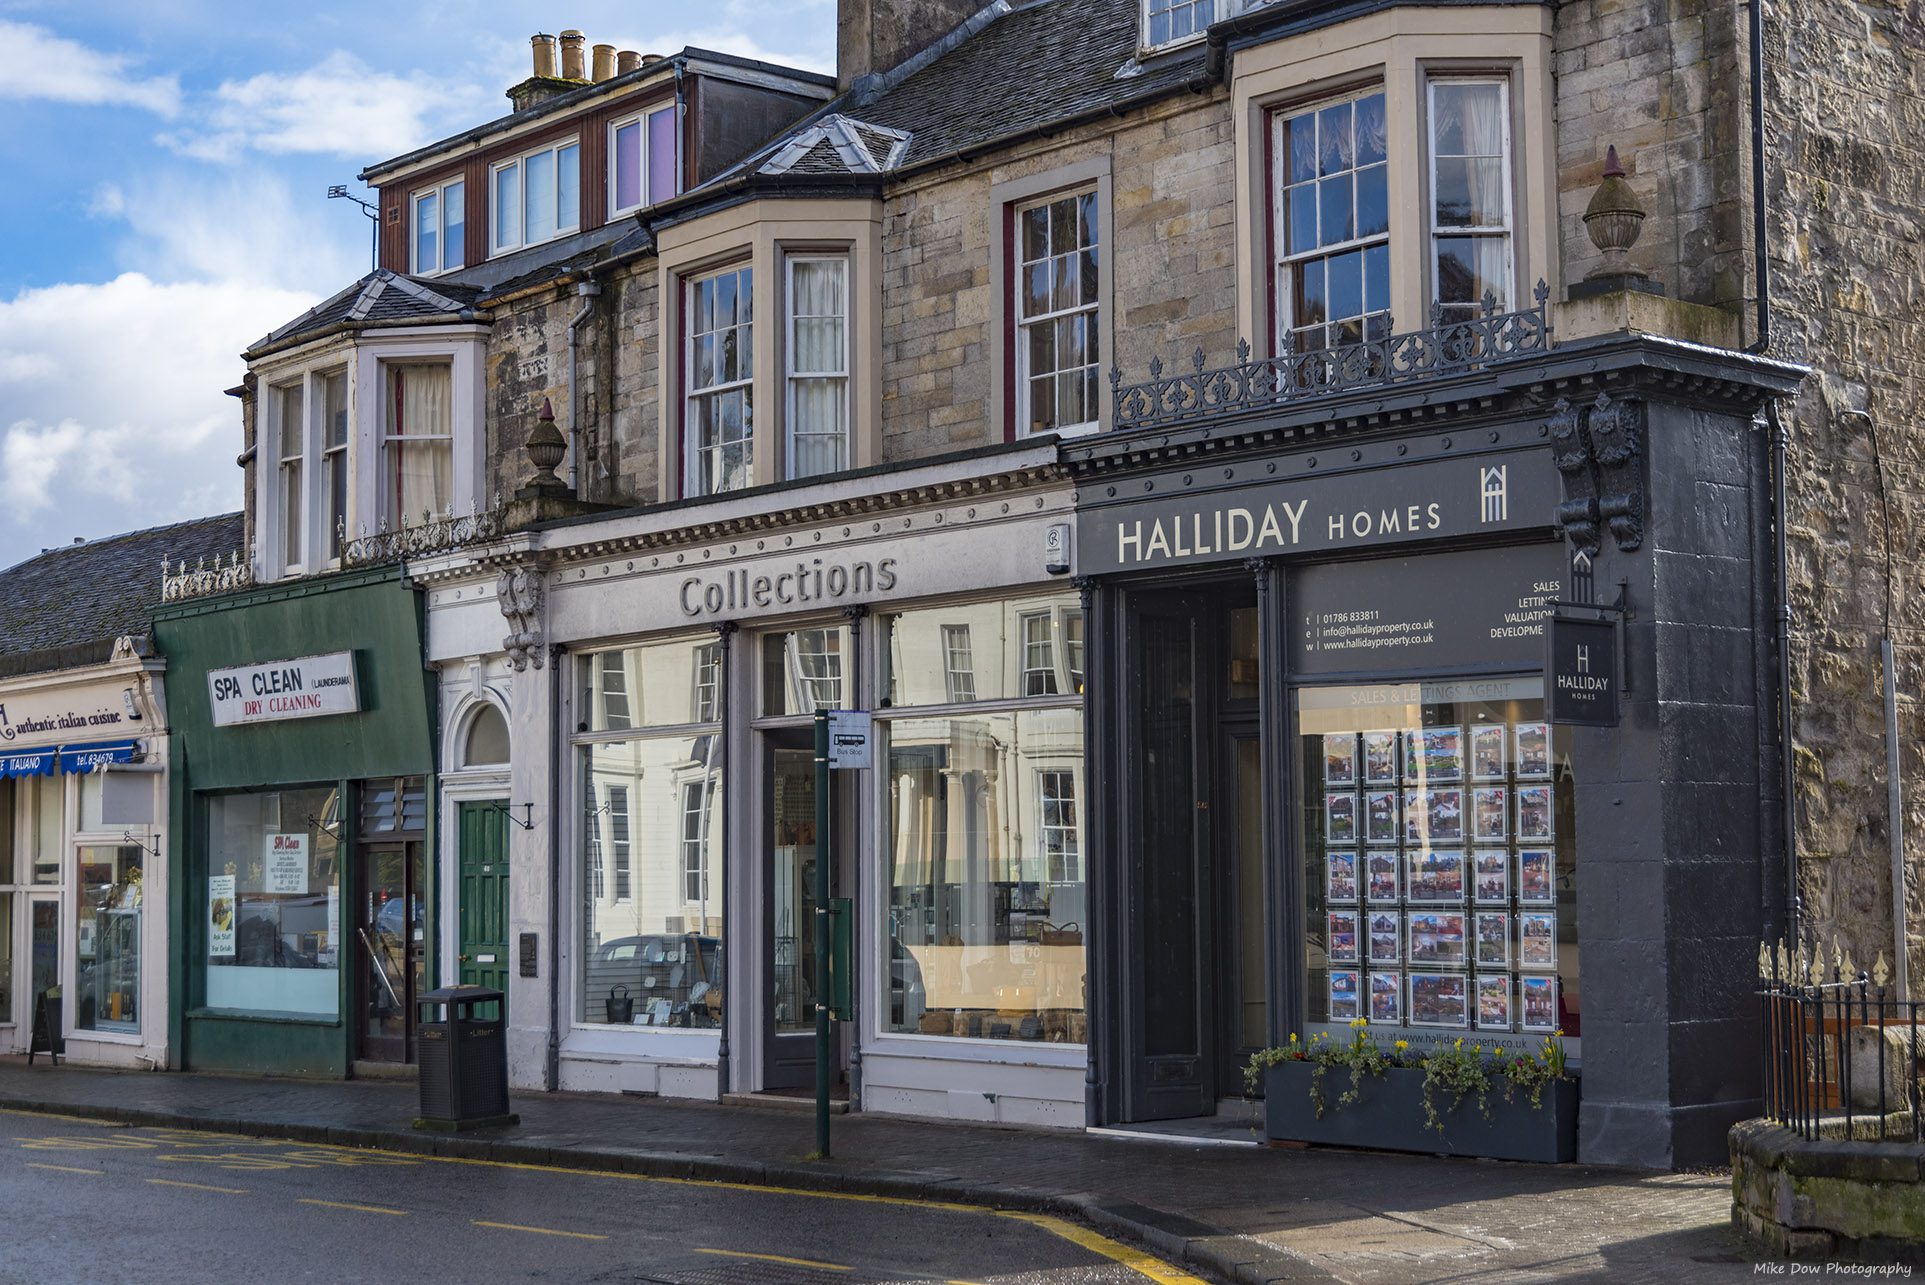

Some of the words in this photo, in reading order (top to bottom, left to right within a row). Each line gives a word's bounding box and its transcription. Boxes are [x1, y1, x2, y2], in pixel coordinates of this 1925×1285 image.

[1117, 500, 1308, 563] HALLIDAY
[1327, 503, 1441, 540] HOMES
[679, 557, 898, 617] Collections
[1533, 581, 1560, 592] SALES
[1306, 616, 1310, 625] t
[1323, 612, 1348, 624] 01786
[1349, 610, 1379, 621] 833811
[1504, 610, 1555, 623] VALUATION
[1306, 630, 1311, 638] e
[1323, 619, 1434, 637] info@hallidayproperty.co.uk
[1490, 625, 1543, 638] DEVELOPME
[1323, 633, 1433, 650] www.hallidayproperty.co.uk
[214, 676, 242, 701] SPA
[252, 667, 303, 696] CLEAN
[1558, 675, 1608, 690] HALLIDAY
[1351, 689, 1387, 705] SALES
[1391, 689, 1400, 702] &
[1466, 683, 1511, 698] AGENT
[1572, 692, 1596, 700] HOMES
[244, 700, 263, 716] DRY
[269, 694, 321, 713] CLEANING
[16, 715, 57, 734] authentic
[58, 712, 87, 729] italian
[88, 708, 122, 725] cuisine
[9, 757, 40, 771] ITALIANO
